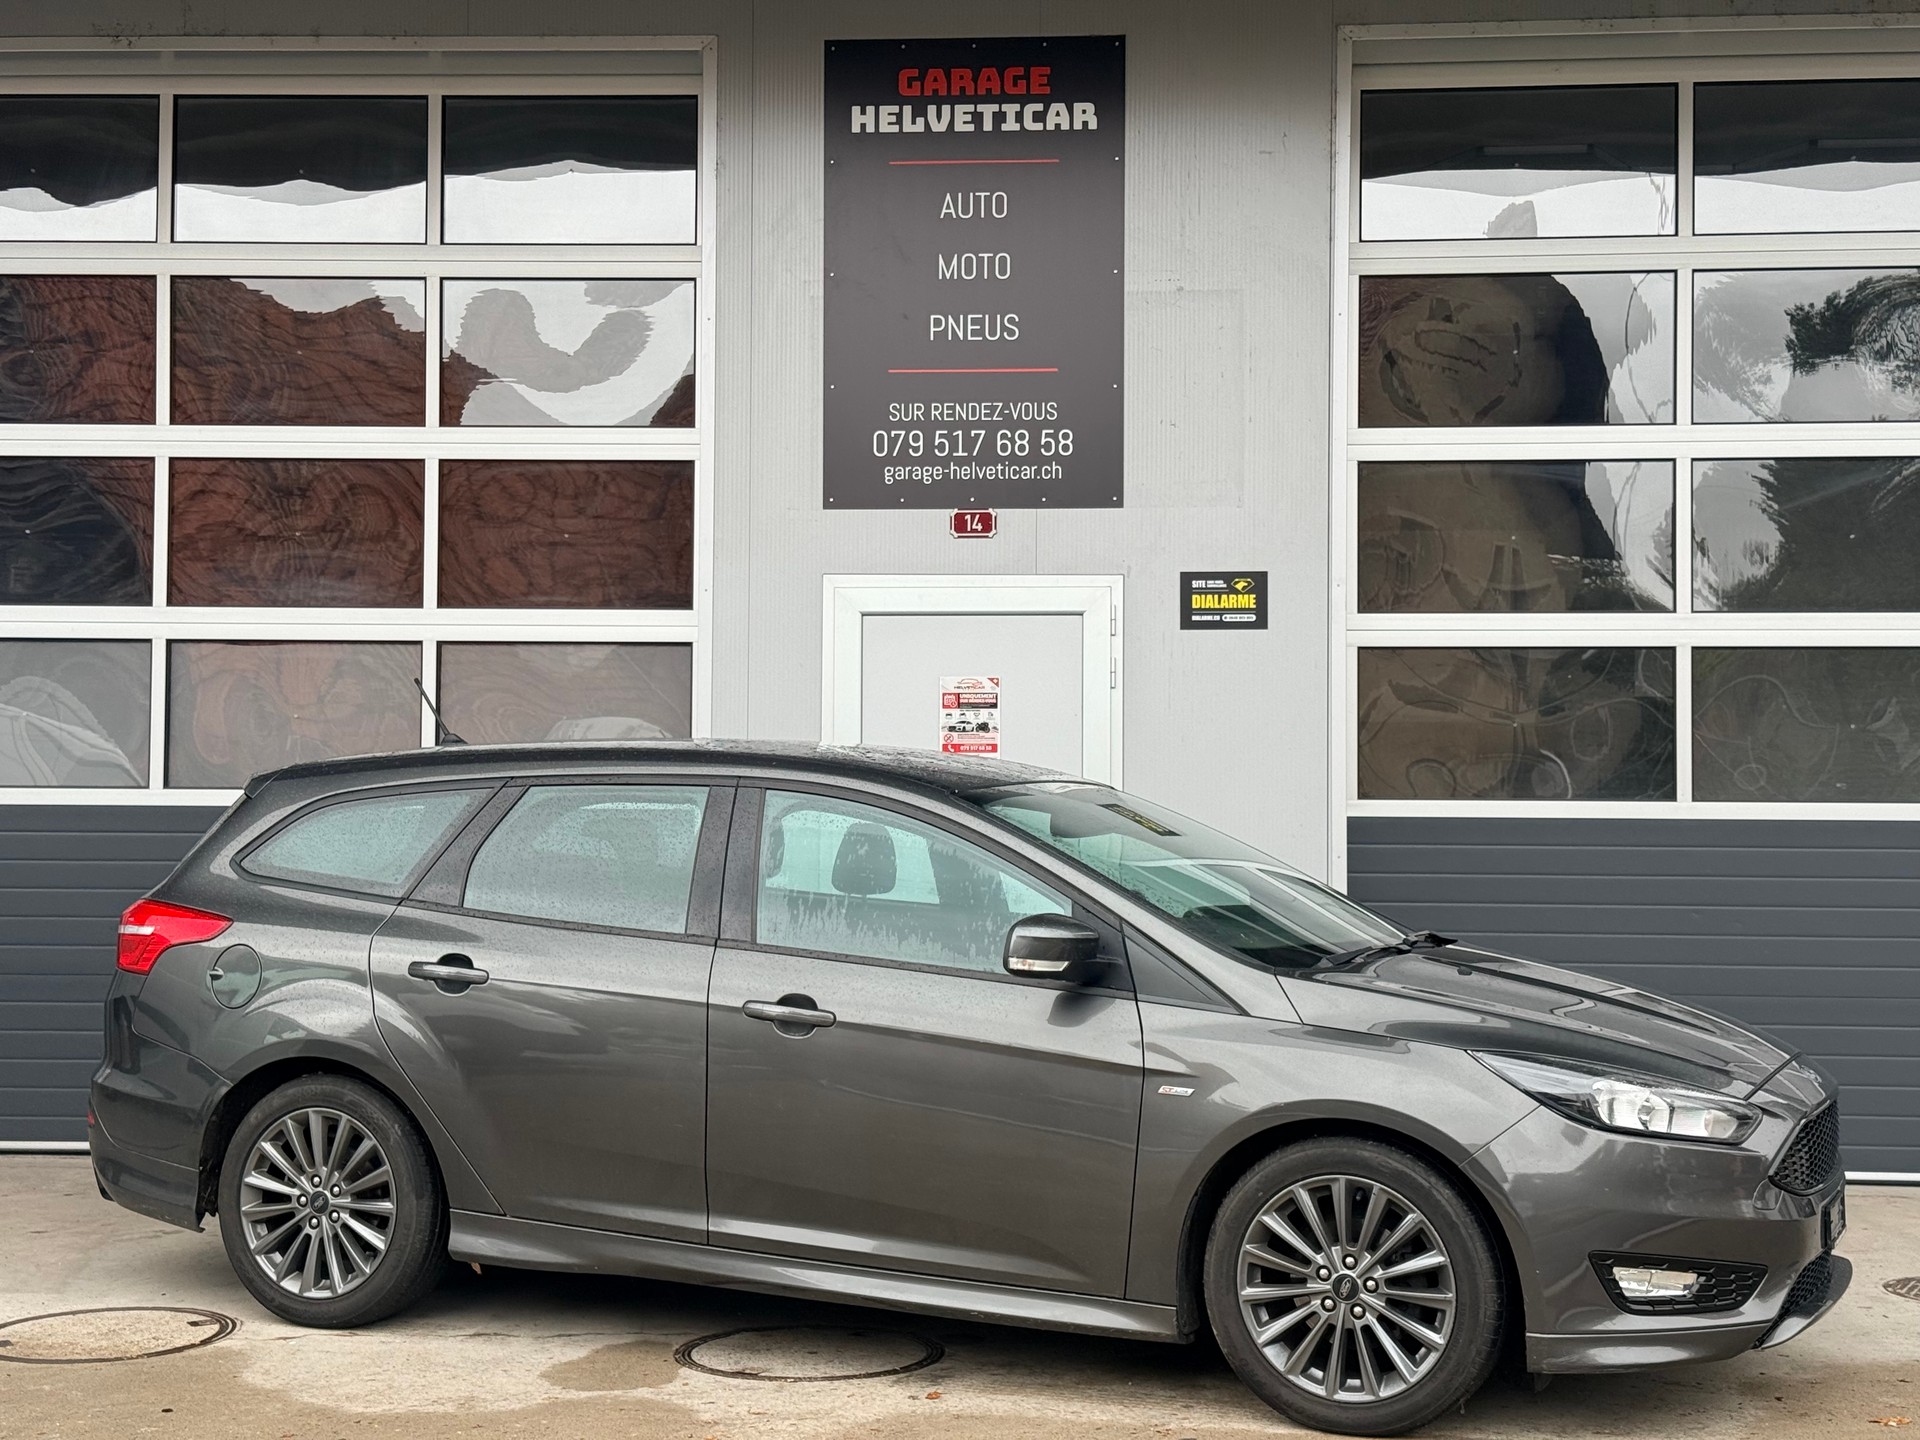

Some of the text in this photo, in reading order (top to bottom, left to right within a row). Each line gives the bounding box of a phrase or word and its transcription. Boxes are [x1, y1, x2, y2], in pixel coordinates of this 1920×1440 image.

[898, 66, 1051, 96] GARAGE
[851, 102, 1098, 133] HELVETICAR
[939, 191, 1008, 219] AUTO
[938, 252, 1011, 280] MOTO
[929, 313, 1020, 341] PNEUS
[888, 401, 1058, 422] SUR RENDEZ-VOUS
[873, 428, 1074, 457] 079 517 68 58
[884, 461, 1062, 485] garage-helveticar.ch
[964, 514, 983, 532] 14
[1191, 580, 1206, 588] SITE
[1191, 594, 1257, 609] DIALARME
